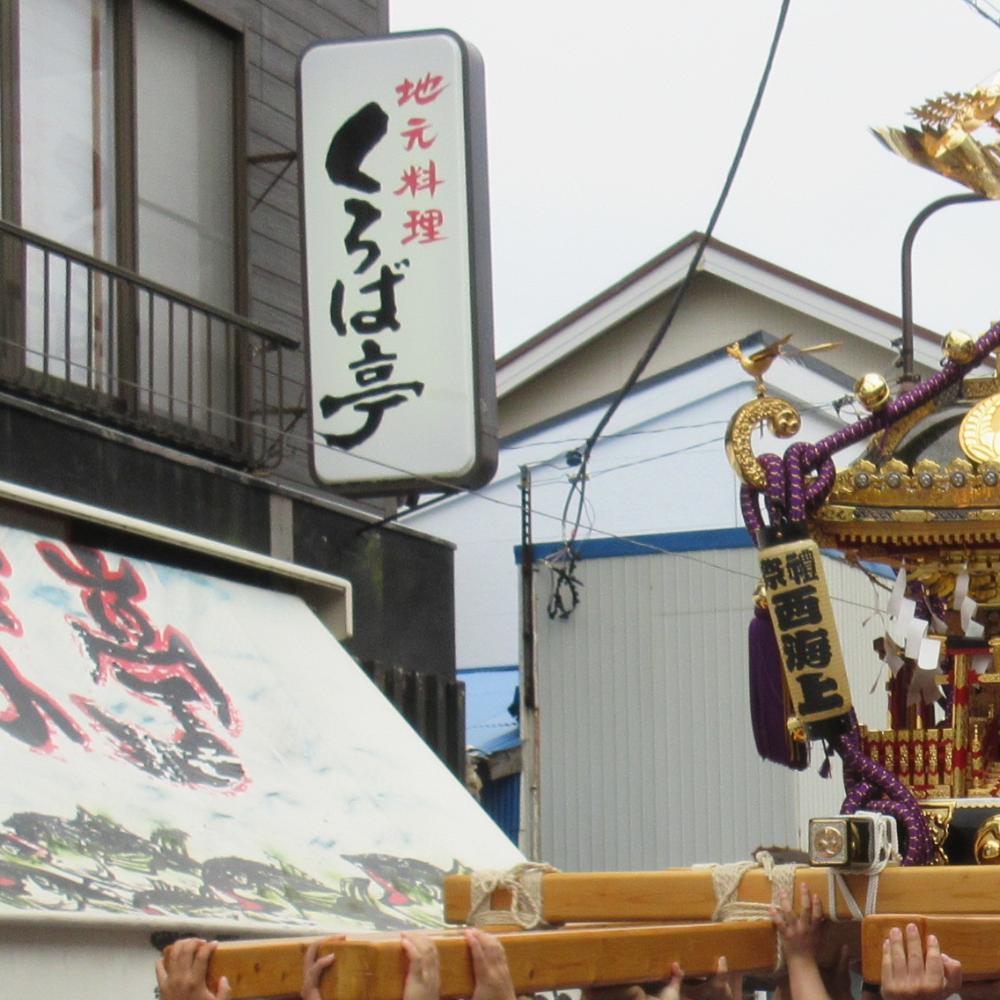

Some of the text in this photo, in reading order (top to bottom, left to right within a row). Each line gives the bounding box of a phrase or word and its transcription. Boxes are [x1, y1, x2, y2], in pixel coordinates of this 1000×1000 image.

[394, 72, 449, 245] 地元料理
[319, 101, 425, 450] くろば亭
[772, 585, 844, 715] 西海上
